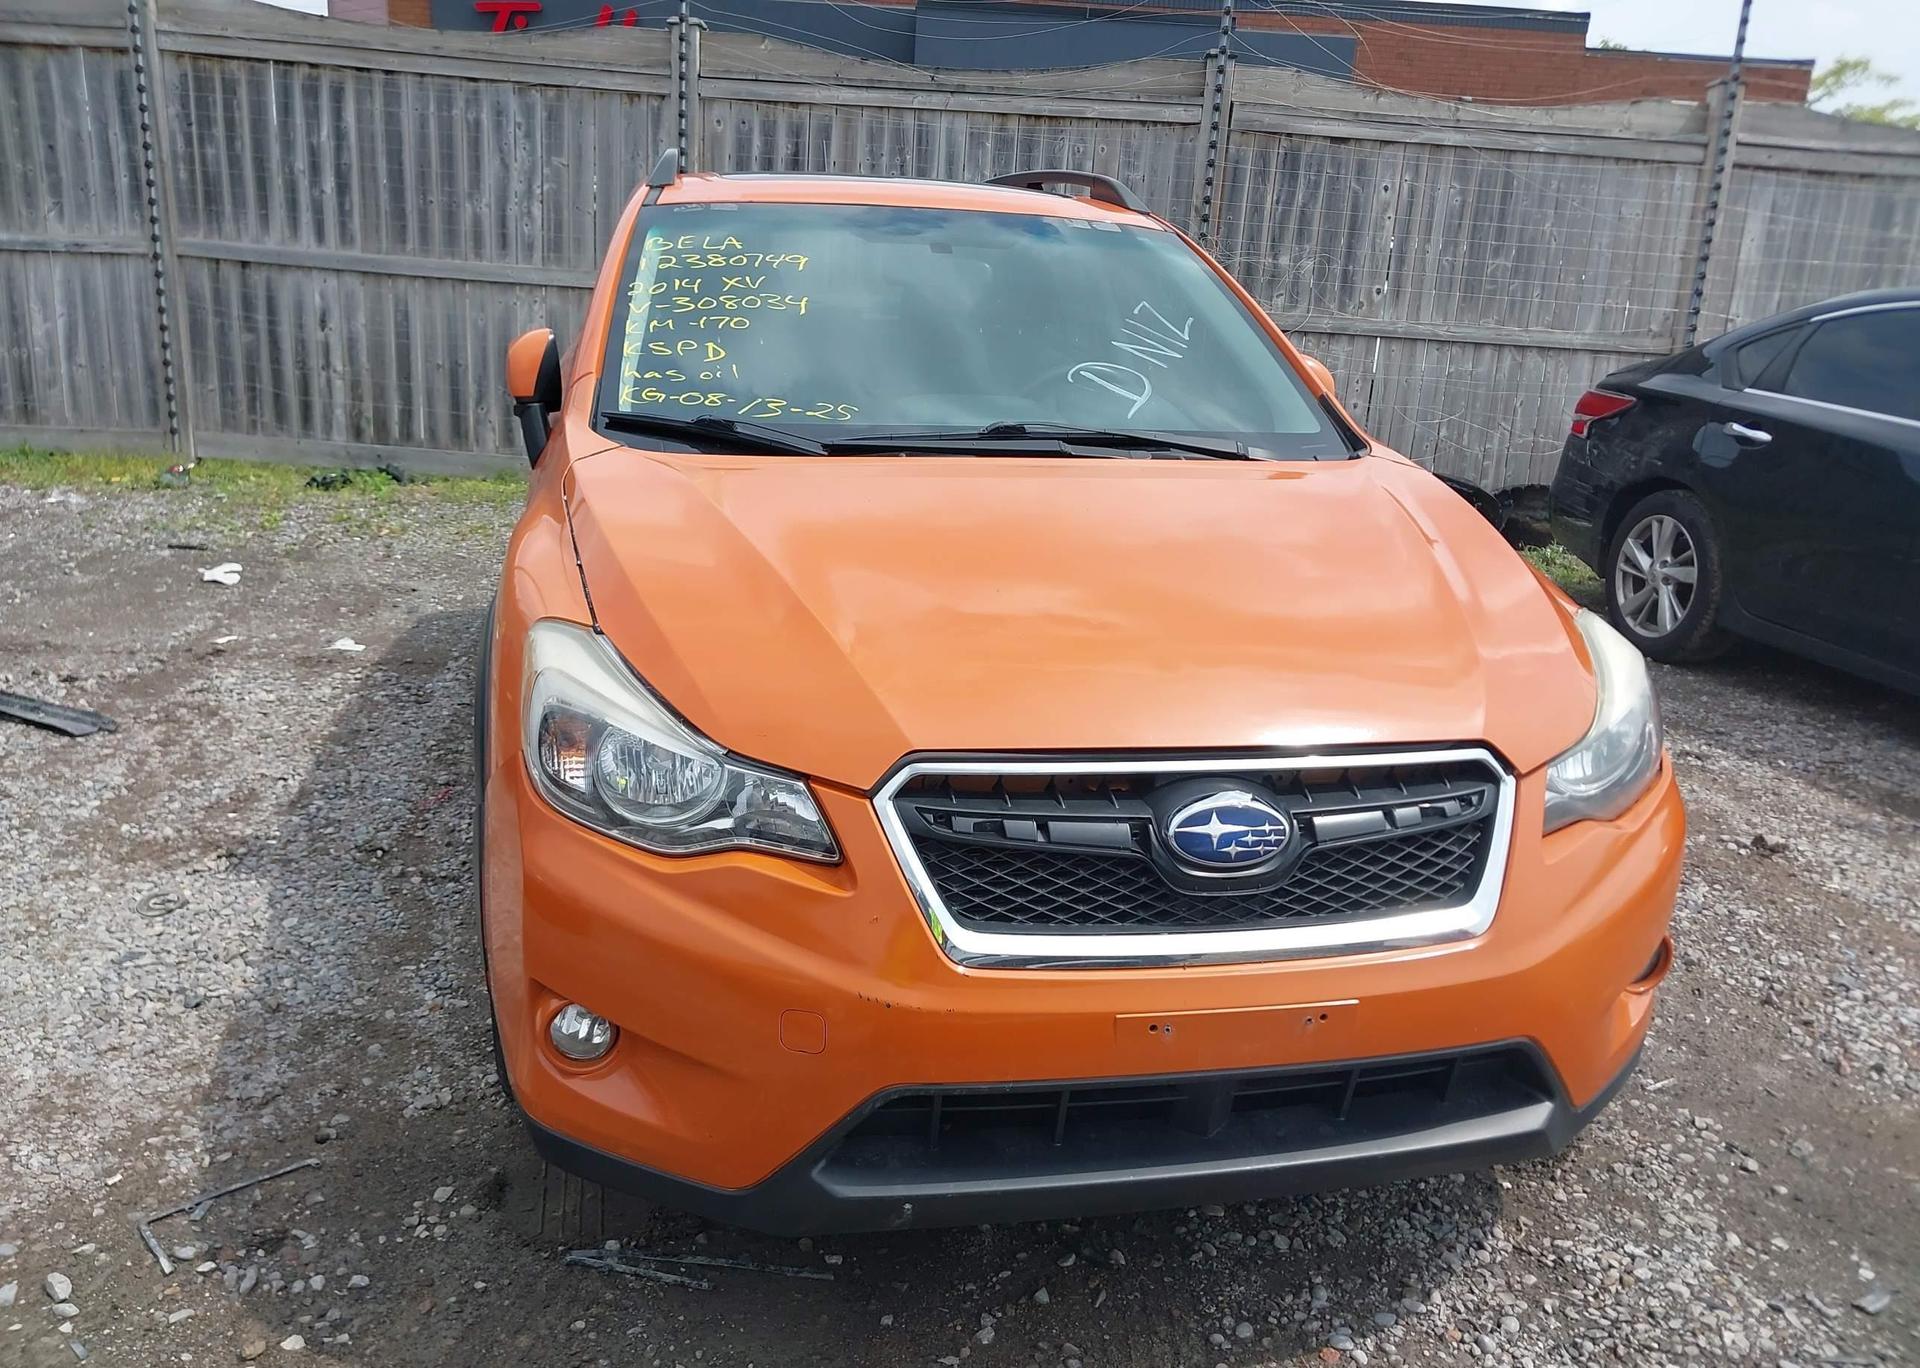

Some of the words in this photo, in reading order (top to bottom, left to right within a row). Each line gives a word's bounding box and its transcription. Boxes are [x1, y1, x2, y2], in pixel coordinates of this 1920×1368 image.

[645, 236, 743, 251] BELA
[640, 252, 809, 272] 12380749
[627, 278, 702, 295] 2014
[722, 276, 766, 292] XV
[699, 364, 739, 380] oil
